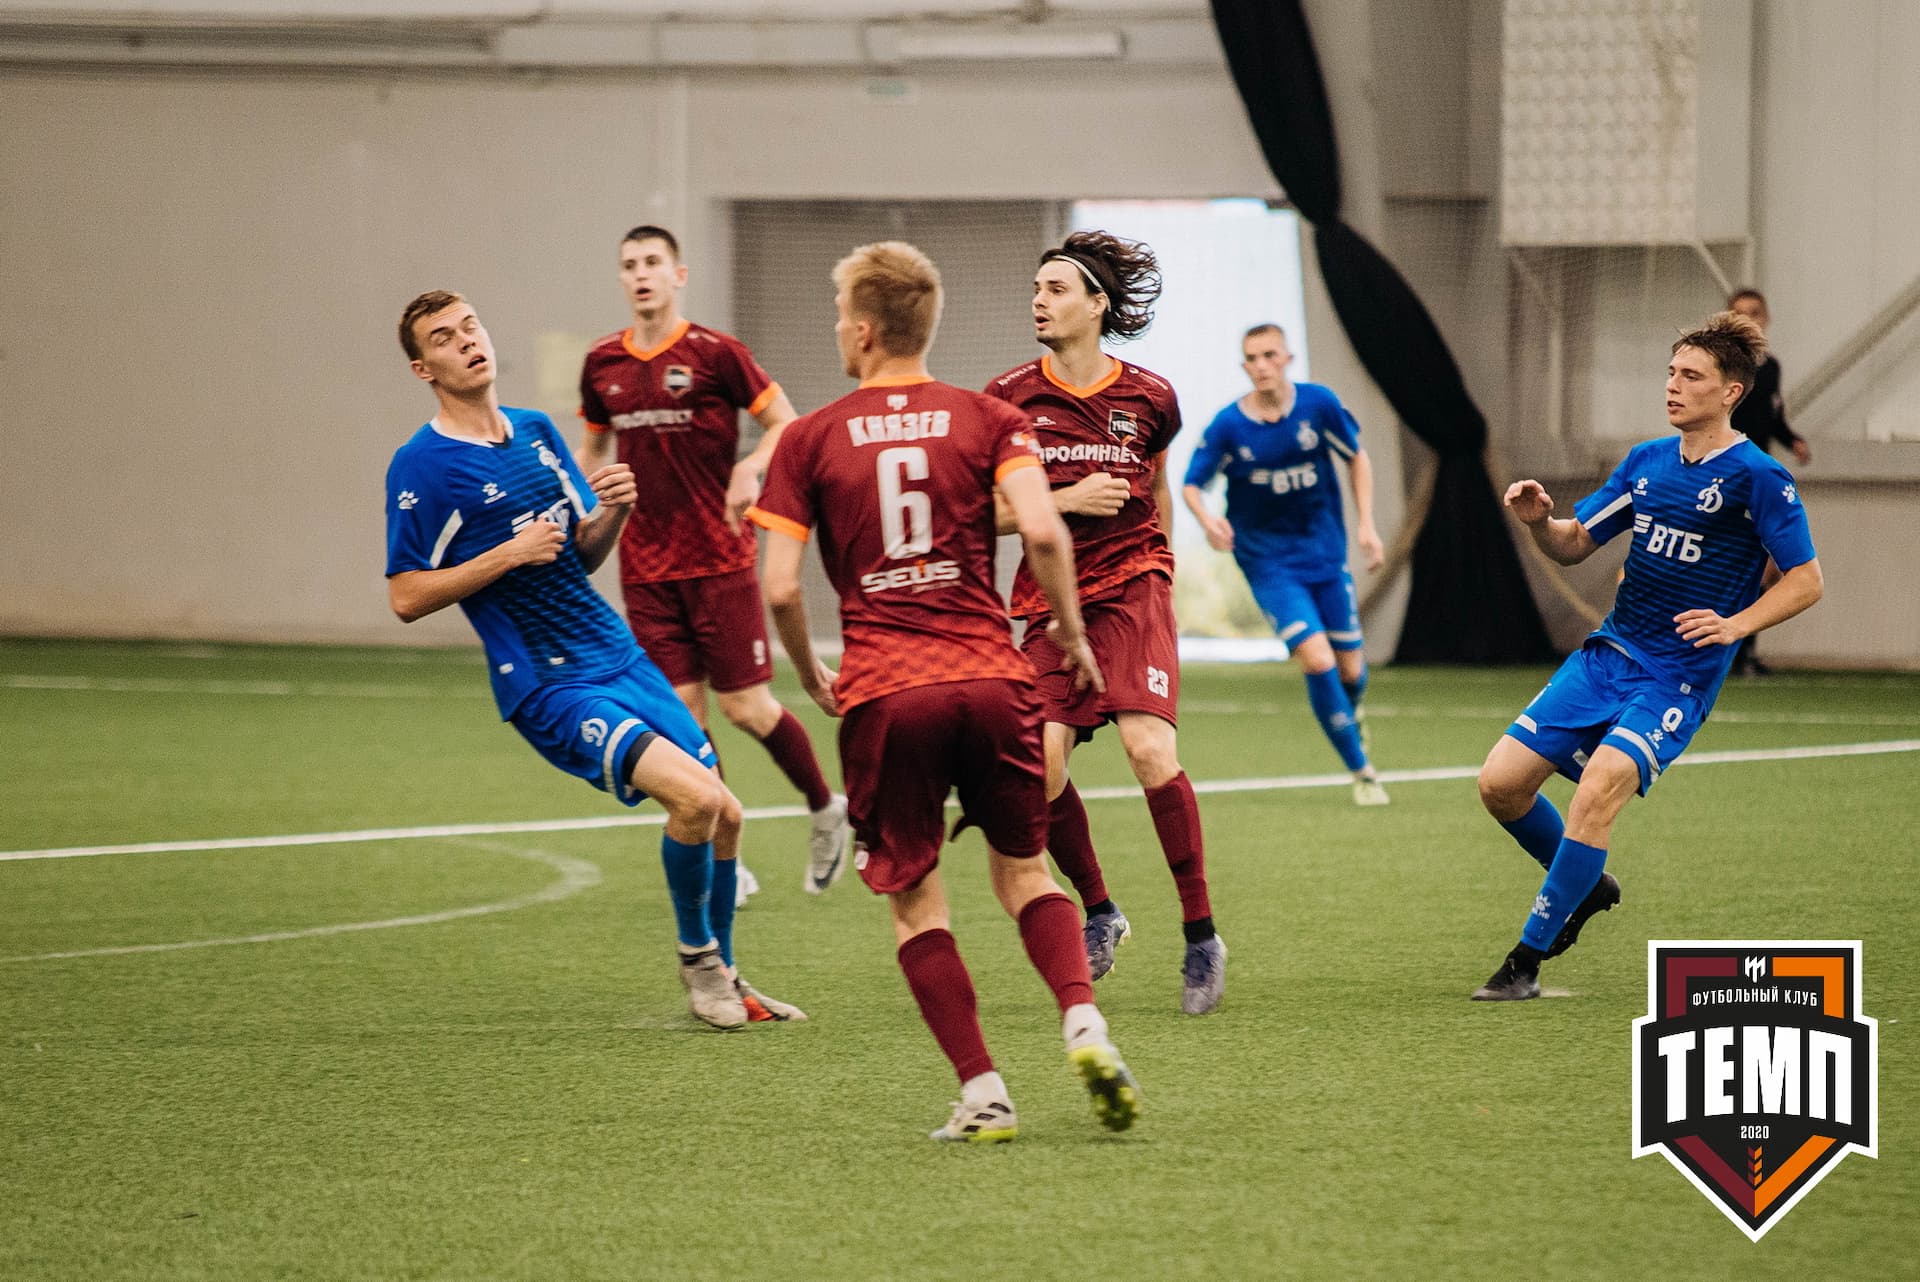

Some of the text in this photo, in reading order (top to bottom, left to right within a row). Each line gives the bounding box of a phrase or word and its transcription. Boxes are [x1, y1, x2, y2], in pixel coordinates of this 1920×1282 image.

[847, 410, 951, 447] КНЯЗЕВ
[1272, 462, 1318, 494] ВТБ
[876, 446, 933, 560] 6
[1646, 523, 1704, 563] ВТБ
[1147, 665, 1169, 699] 23
